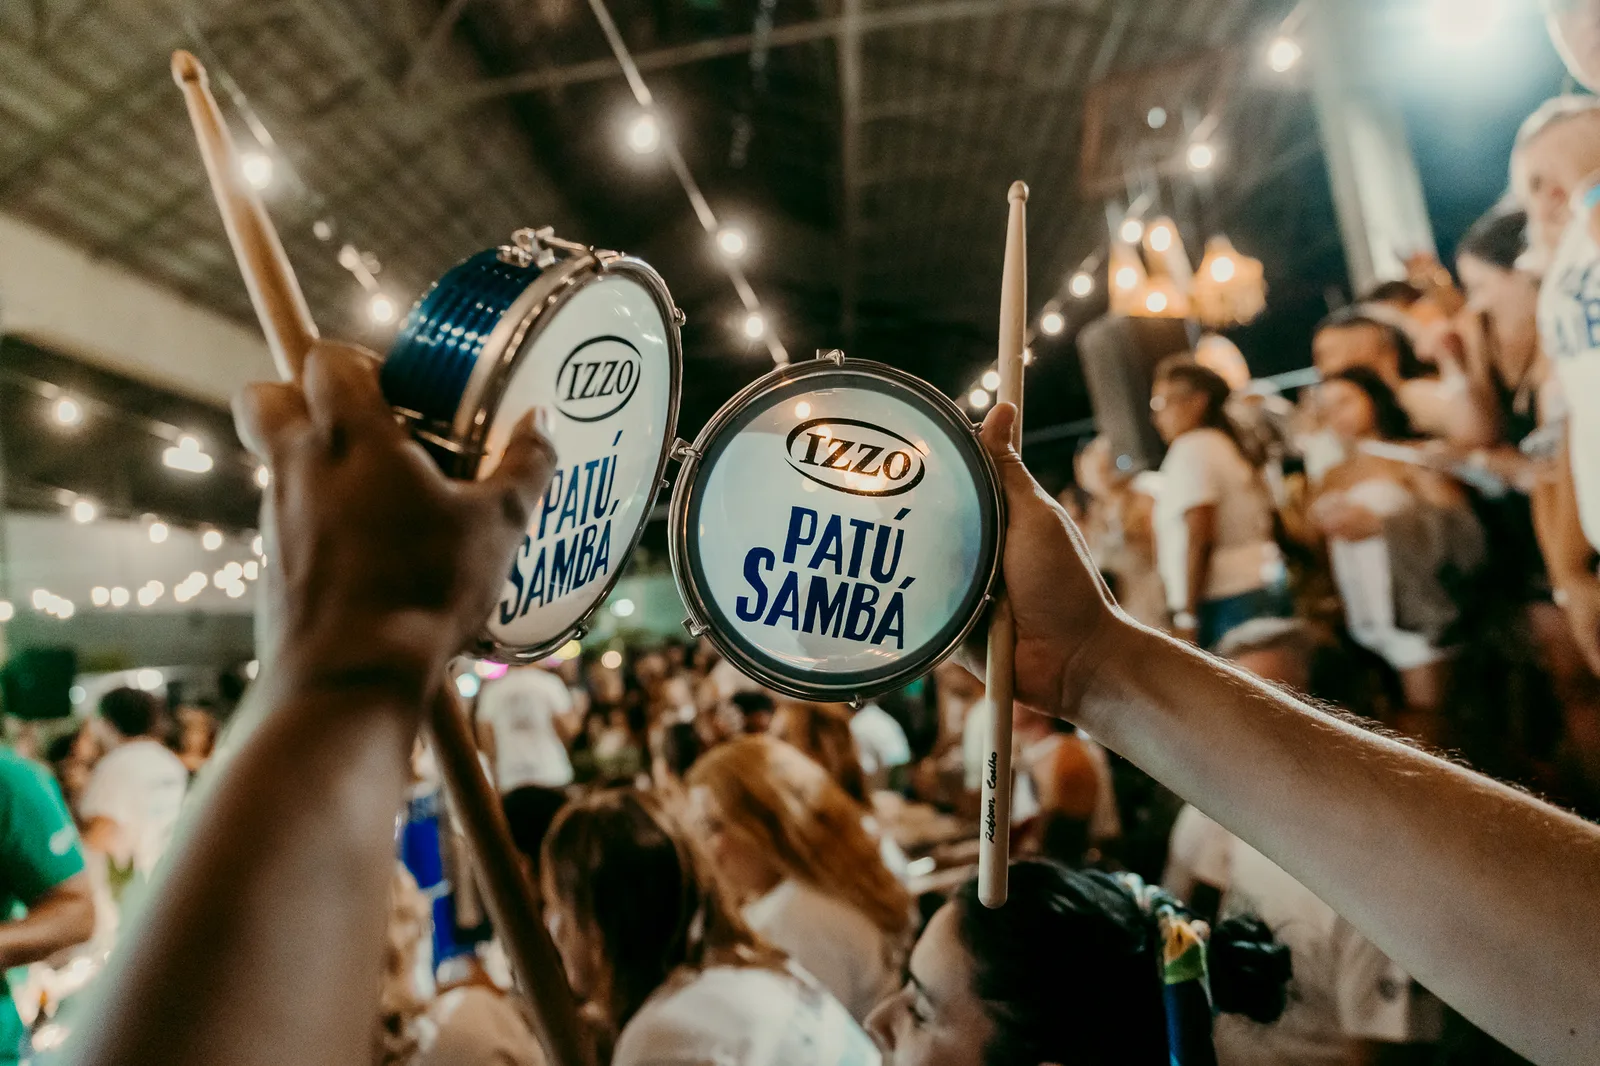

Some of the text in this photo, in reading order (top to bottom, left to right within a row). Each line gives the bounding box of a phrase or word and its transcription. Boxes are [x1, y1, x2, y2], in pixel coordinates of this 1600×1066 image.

[565, 360, 633, 401] IZZO
[538, 430, 623, 540] PATÚ
[799, 432, 912, 481] IZZO
[782, 505, 912, 584] PATÚ
[736, 546, 917, 650] SAMBÁ
